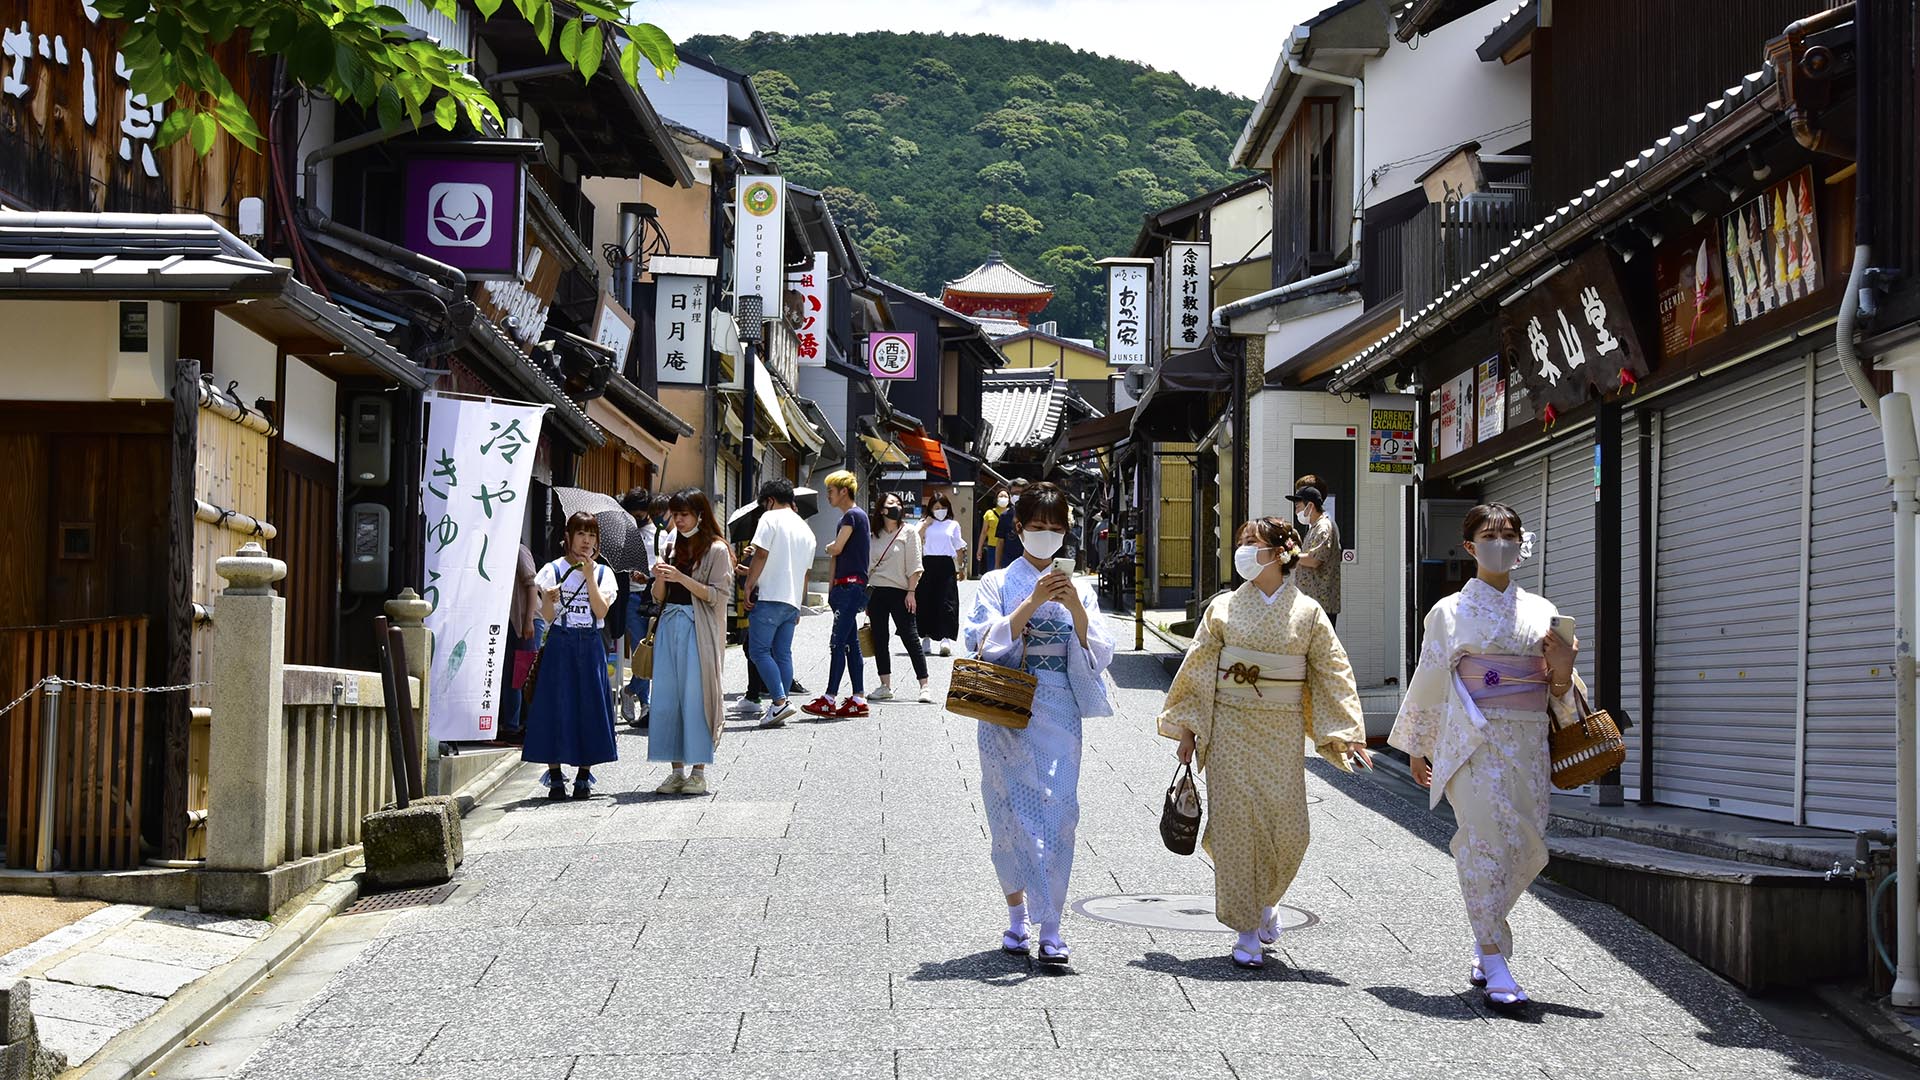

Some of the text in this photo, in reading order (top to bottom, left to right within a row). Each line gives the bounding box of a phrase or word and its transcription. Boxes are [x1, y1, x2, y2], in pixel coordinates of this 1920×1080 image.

[755, 224, 763, 297] pure gre
[690, 283, 703, 323] 京料理
[663, 293, 688, 371] 日月庵
[884, 342, 900, 369] 西尾
[1372, 410, 1414, 421] CURRENCY
[1372, 419, 1413, 431] EXCHANGE
[472, 418, 531, 583] 冷やし
[425, 447, 459, 664] きゅう
